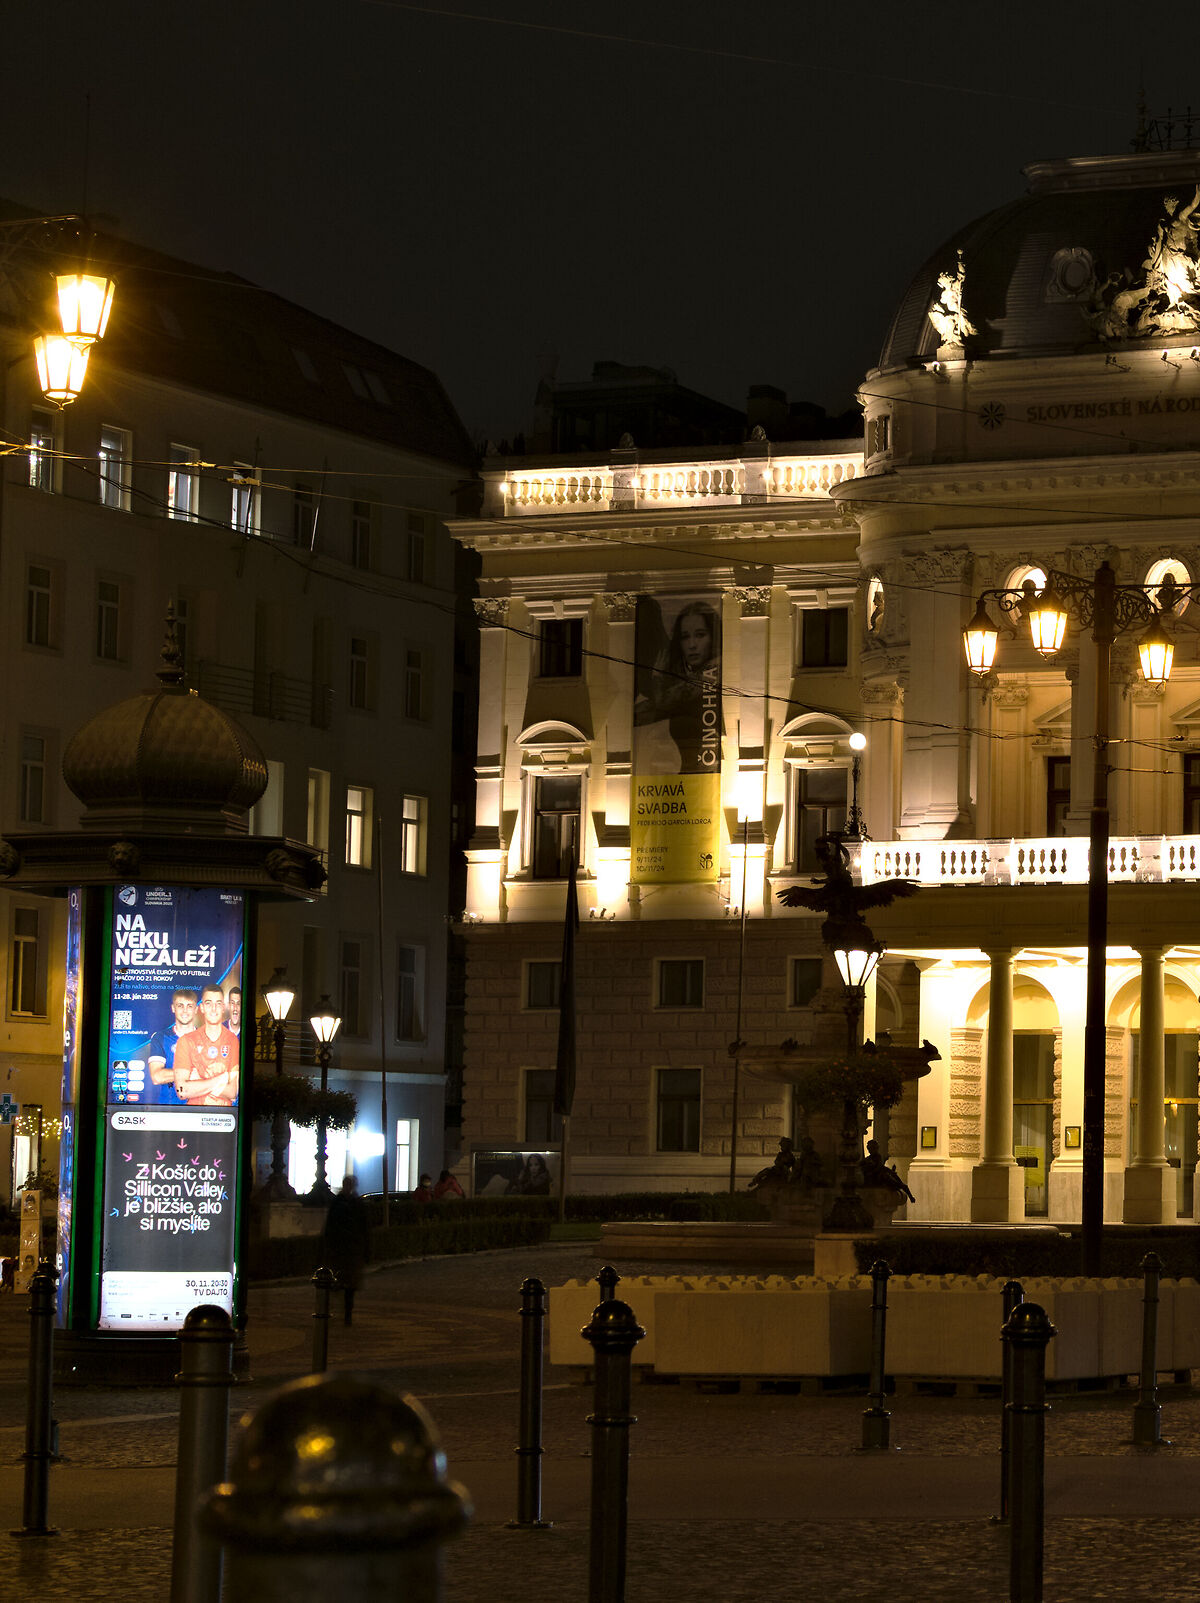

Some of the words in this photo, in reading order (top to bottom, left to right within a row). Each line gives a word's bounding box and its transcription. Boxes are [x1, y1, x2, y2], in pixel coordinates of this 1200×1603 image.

[1027, 398, 1132, 423] SLOVENSKÉ
[698, 666, 718, 766] ČINOHRA
[638, 781, 685, 797] KRVAVÁ
[637, 802, 687, 815] SVADBA
[637, 856, 662, 864] 9/11/24
[117, 914, 146, 931] NA
[116, 932, 168, 949] VEKU
[115, 943, 216, 968] NEZÁLEŽÍ
[135, 1164, 149, 1179] Z
[152, 1164, 196, 1180] Košíc
[199, 1165, 217, 1180] do
[124, 1180, 181, 1197] Sillicon
[183, 1181, 224, 1201] Valley
[124, 1197, 140, 1217] je
[144, 1198, 196, 1216] bližšie,
[198, 1198, 222, 1214] ako
[140, 1215, 153, 1231] si
[157, 1214, 210, 1234] myslíte
